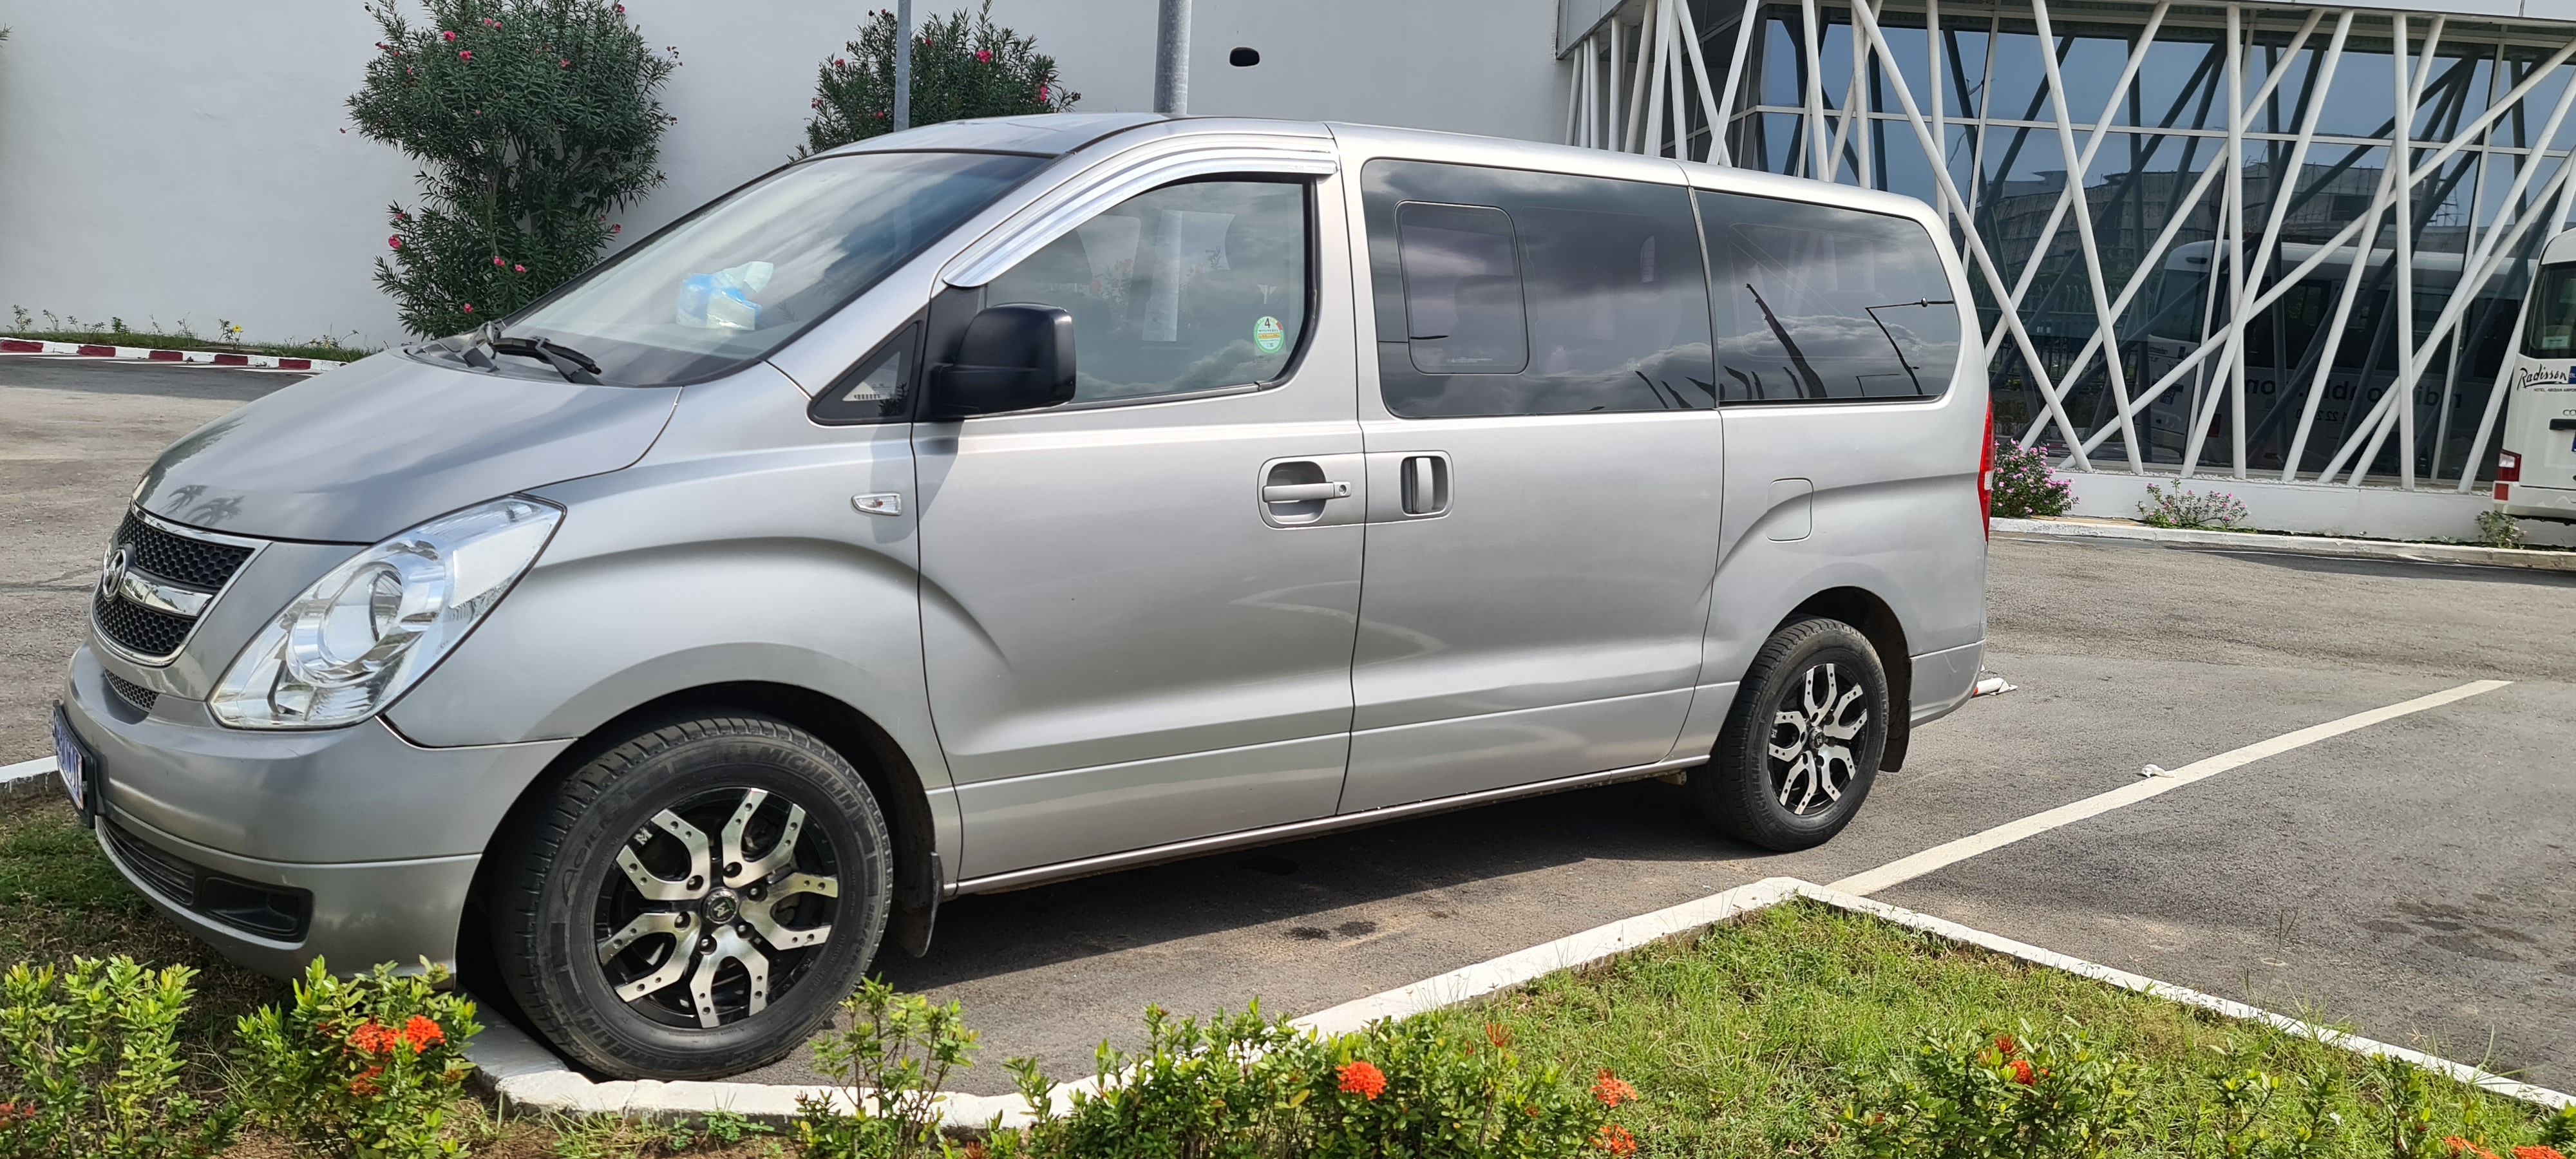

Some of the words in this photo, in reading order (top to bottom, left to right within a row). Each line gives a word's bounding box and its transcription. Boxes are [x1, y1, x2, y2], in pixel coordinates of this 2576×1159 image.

[1264, 317, 1271, 328] 4
[2516, 363, 2567, 391] Radisson
[757, 746, 862, 817] MICHELIN
